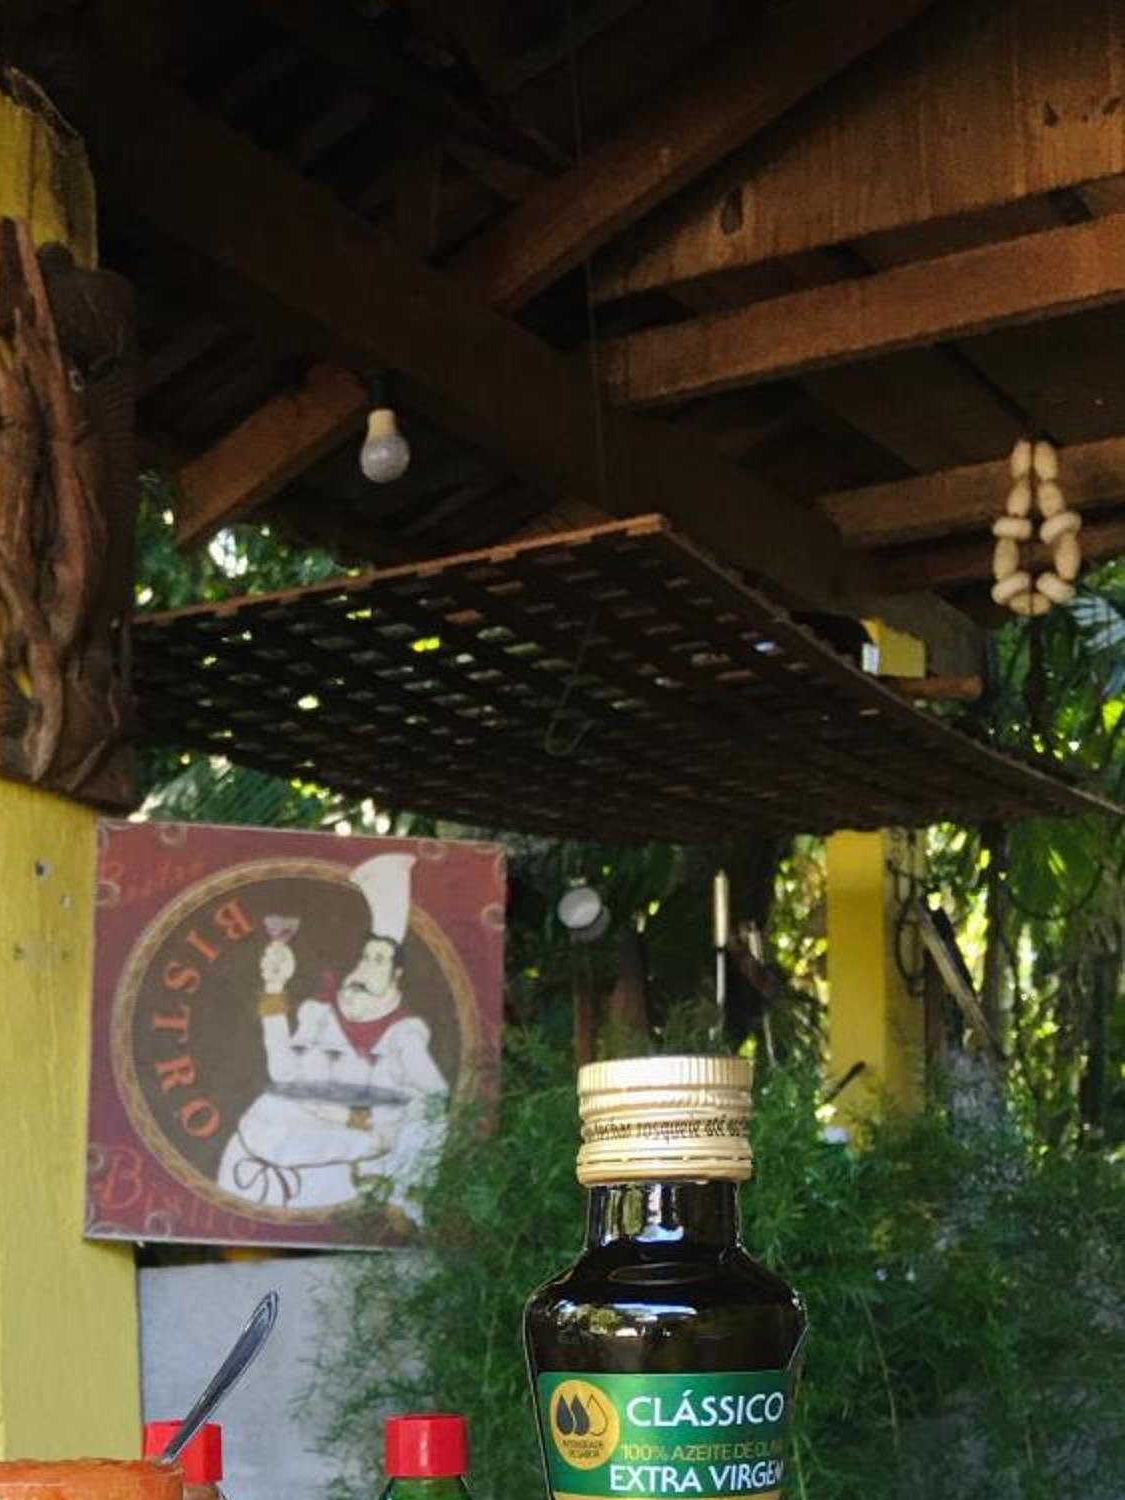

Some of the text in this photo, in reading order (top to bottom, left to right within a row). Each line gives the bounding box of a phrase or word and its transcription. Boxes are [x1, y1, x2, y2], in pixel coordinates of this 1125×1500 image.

[151, 897, 257, 1139] BISTRO
[626, 1389, 785, 1428] CLÁSSICO
[670, 1442, 732, 1462] AZEITE
[609, 1465, 703, 1493] EXTRA
